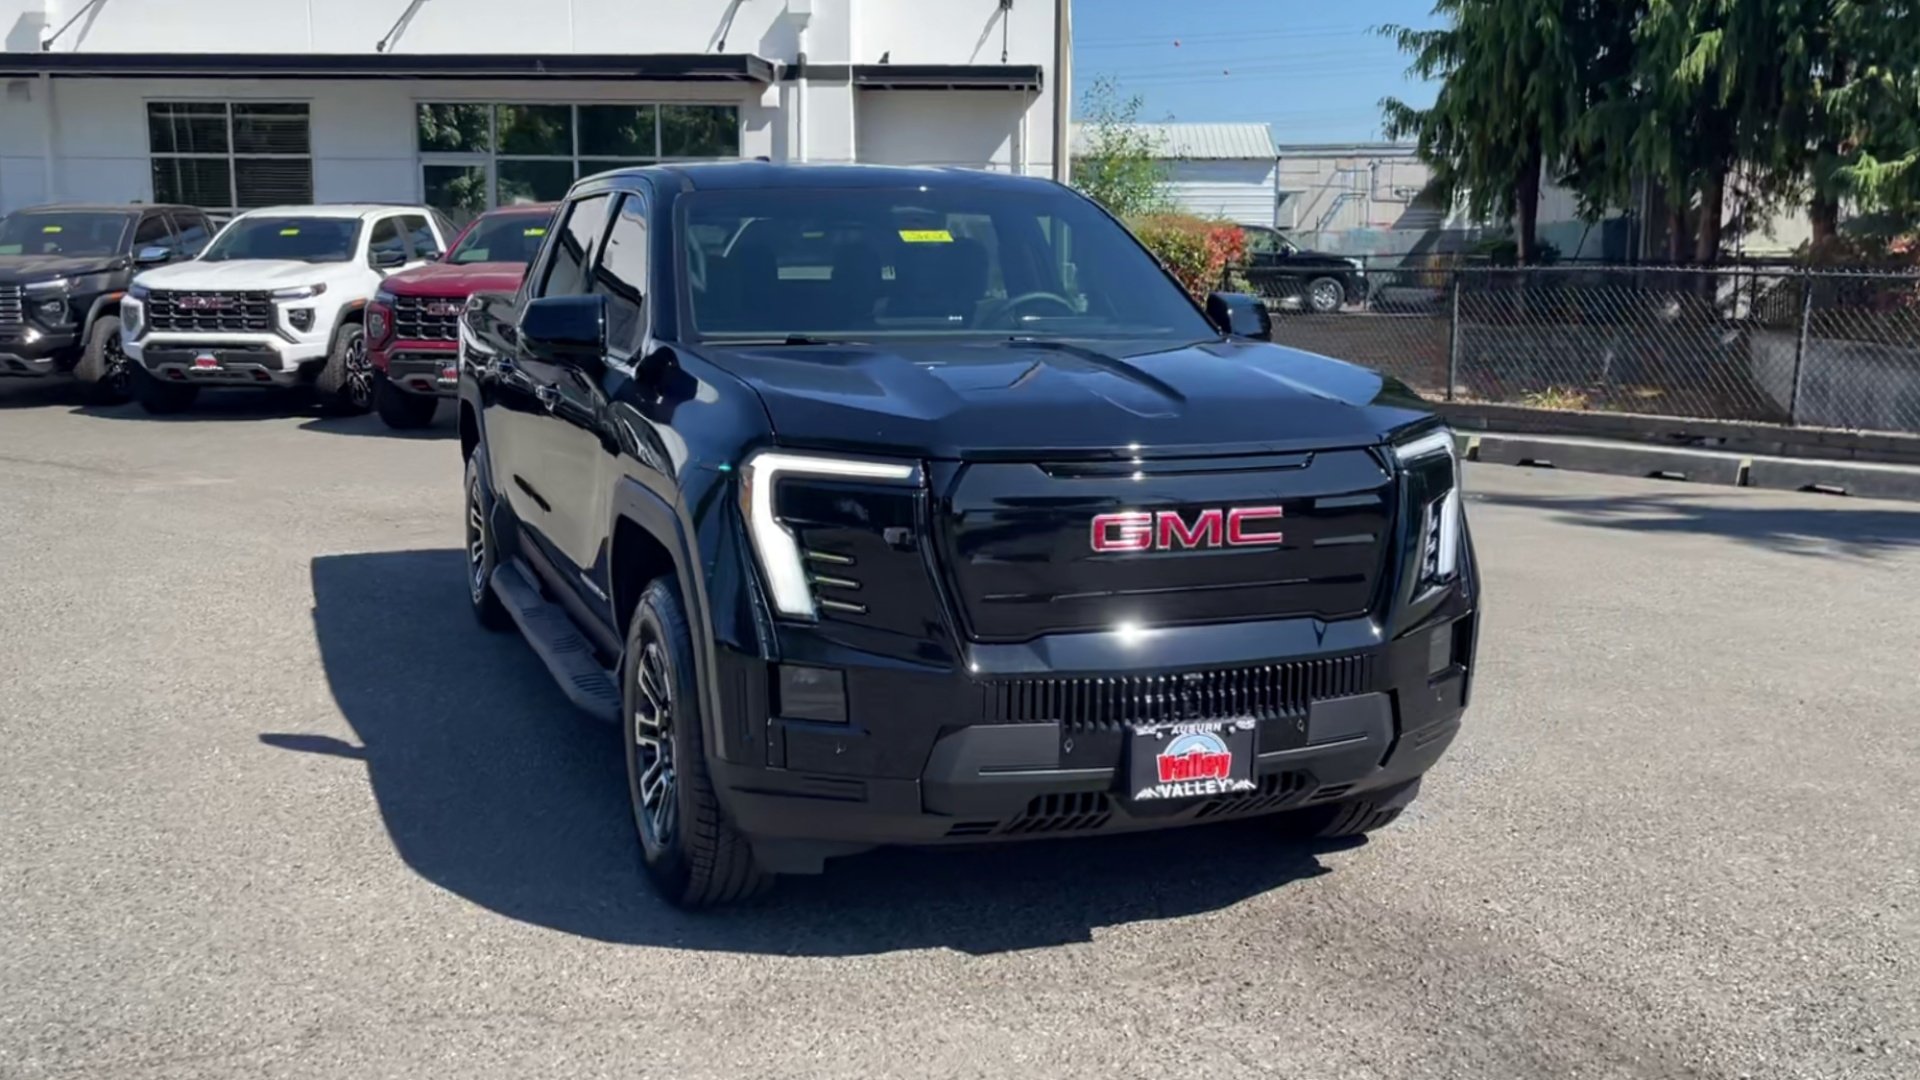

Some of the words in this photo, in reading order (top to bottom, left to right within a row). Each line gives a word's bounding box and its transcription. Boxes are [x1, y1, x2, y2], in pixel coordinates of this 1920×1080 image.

[1091, 506, 1283, 552] GMC
[1171, 723, 1222, 735] AUBURN
[1158, 752, 1230, 782] Valley
[1161, 780, 1228, 798] VALLEY
